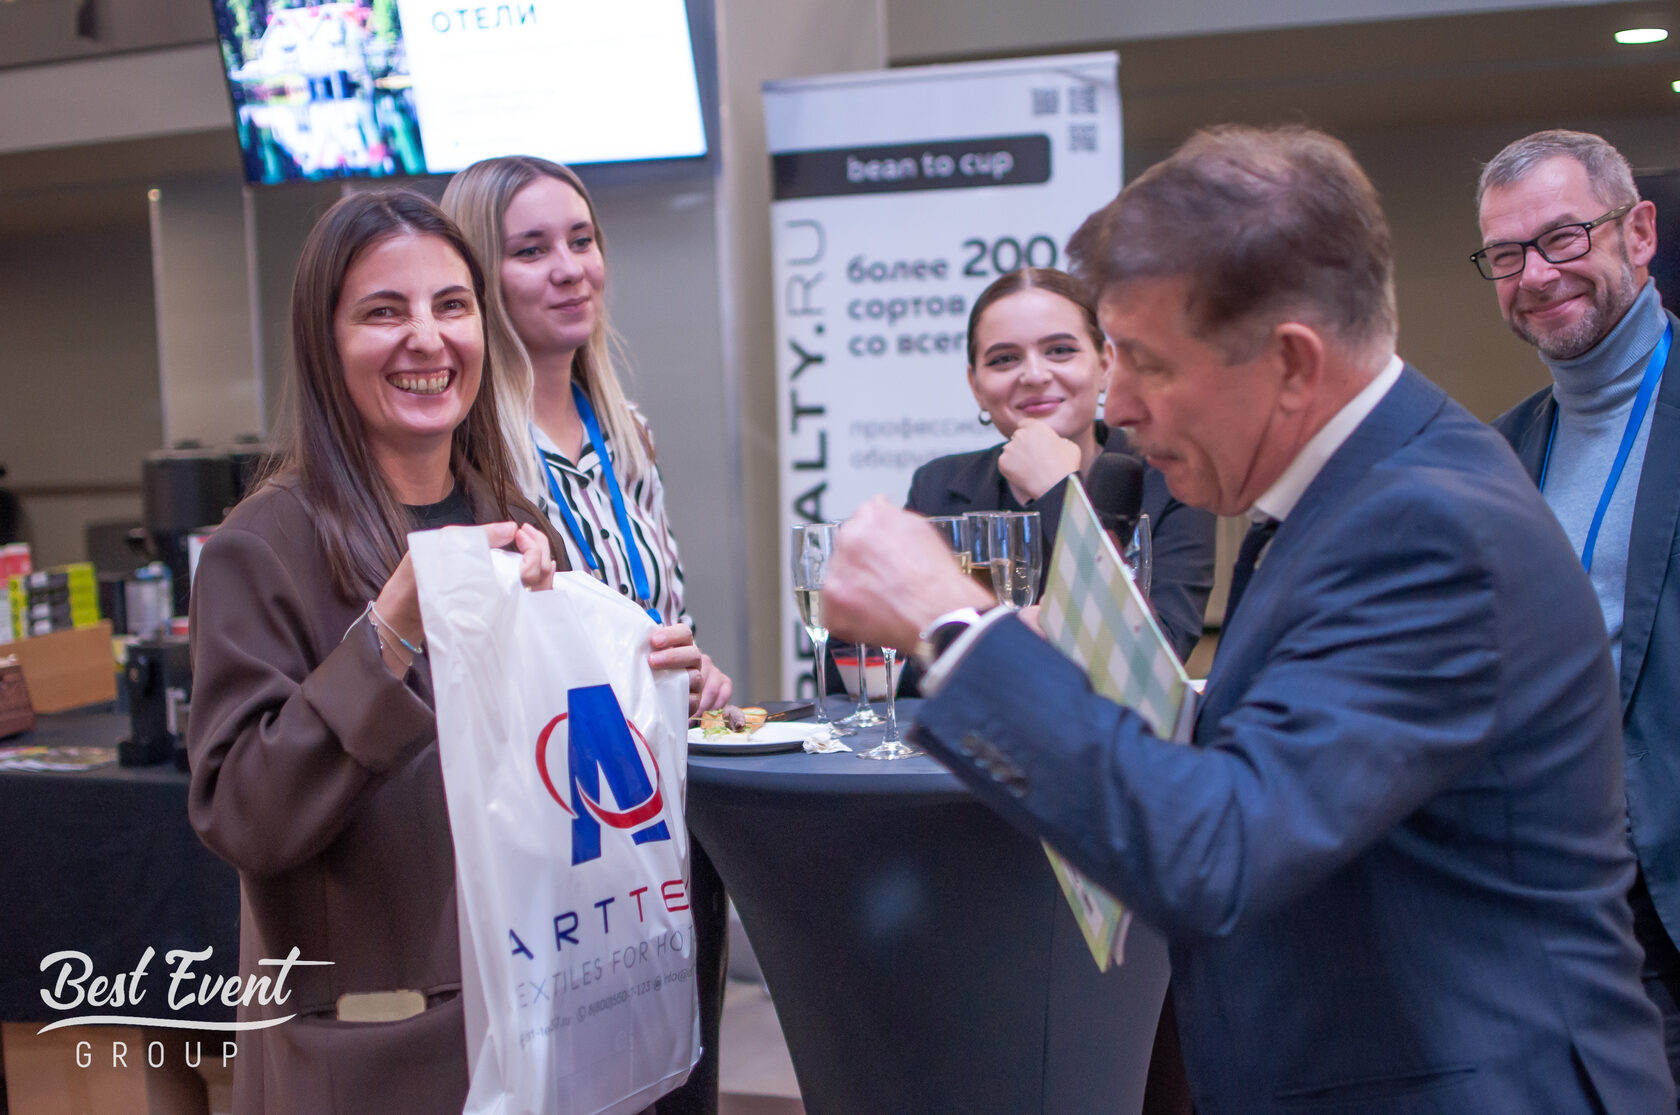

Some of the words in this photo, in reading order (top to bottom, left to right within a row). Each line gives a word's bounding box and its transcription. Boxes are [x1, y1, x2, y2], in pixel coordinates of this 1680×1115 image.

[431, 3, 538, 33] ОТЕЛИ
[846, 155, 918, 182] bean
[921, 152, 954, 177] to
[958, 149, 1015, 180] cup
[847, 255, 949, 283] более
[962, 235, 1057, 278] 200
[848, 295, 966, 325] сортов
[849, 335, 887, 357] со
[897, 331, 969, 355] всег
[509, 876, 690, 960] ARTTE
[517, 957, 603, 1009] EXTILES
[611, 941, 649, 976] FOR
